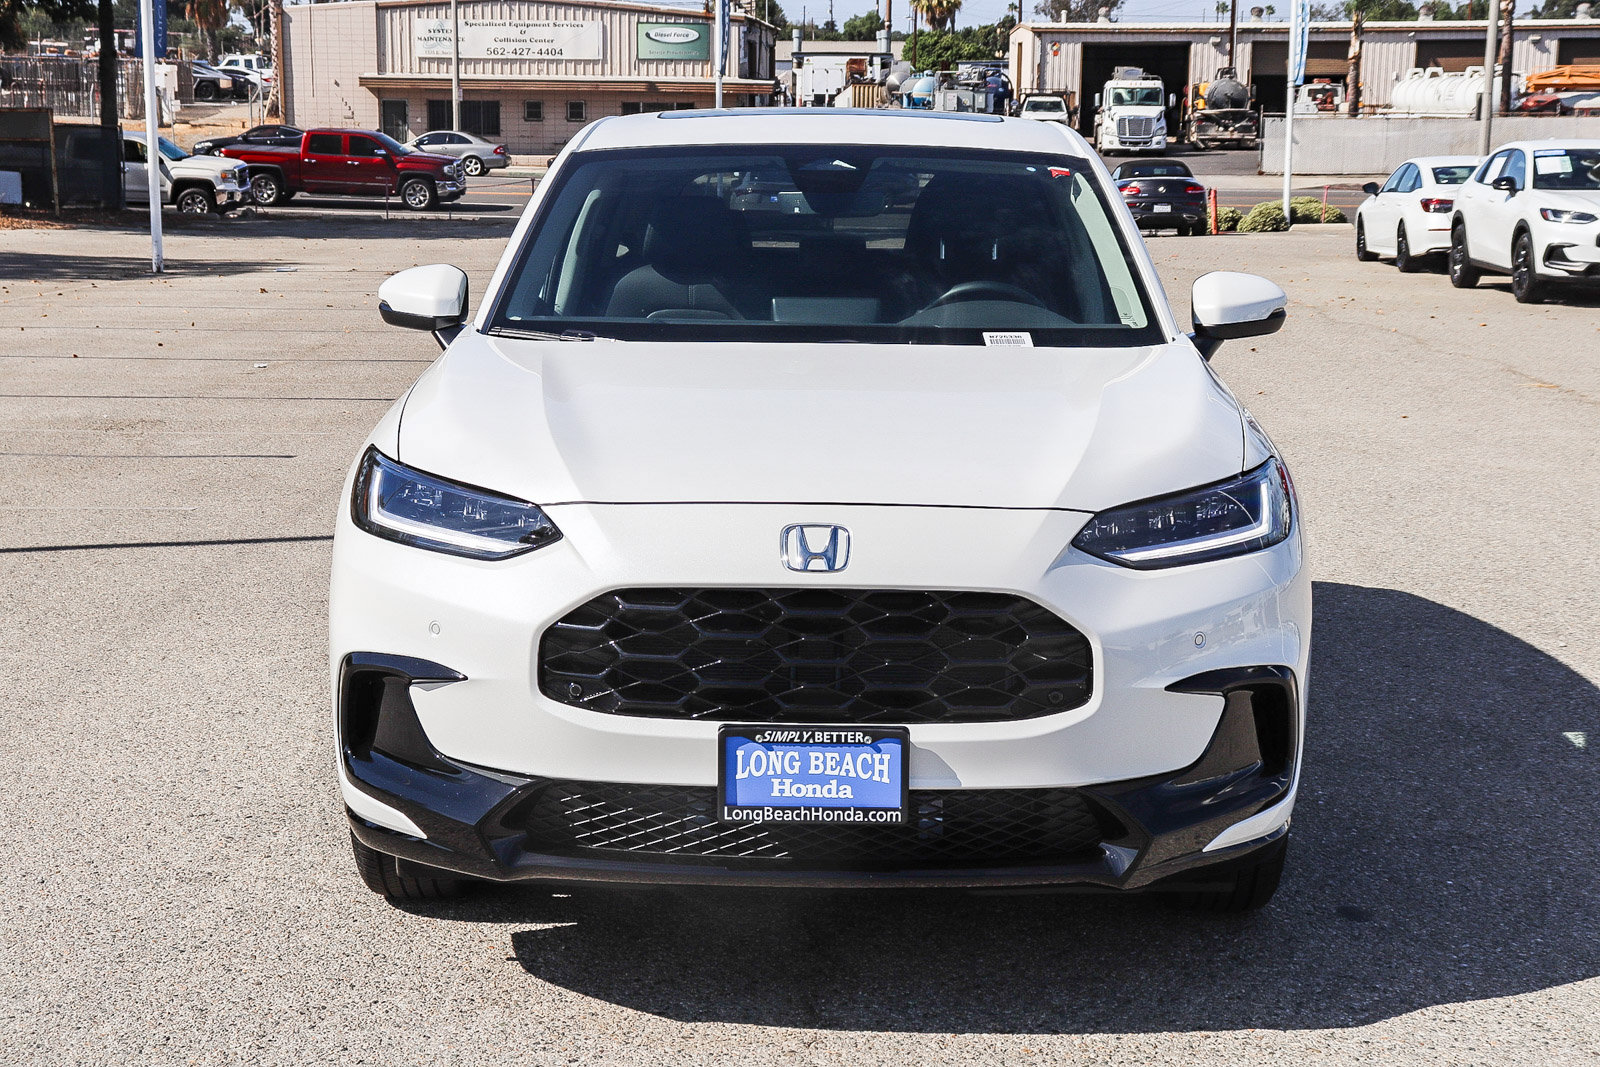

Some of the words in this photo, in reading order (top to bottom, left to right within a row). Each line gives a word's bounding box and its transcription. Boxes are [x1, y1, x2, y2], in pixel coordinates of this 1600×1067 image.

[486, 47, 564, 56] 562-427-4404
[763, 730, 812, 743] SIMPLY
[815, 731, 864, 744] BETTER
[735, 749, 801, 780] LONG
[808, 751, 891, 784] BEACH
[770, 778, 854, 799] Honda
[724, 806, 902, 824] LongBeachHonda.com
